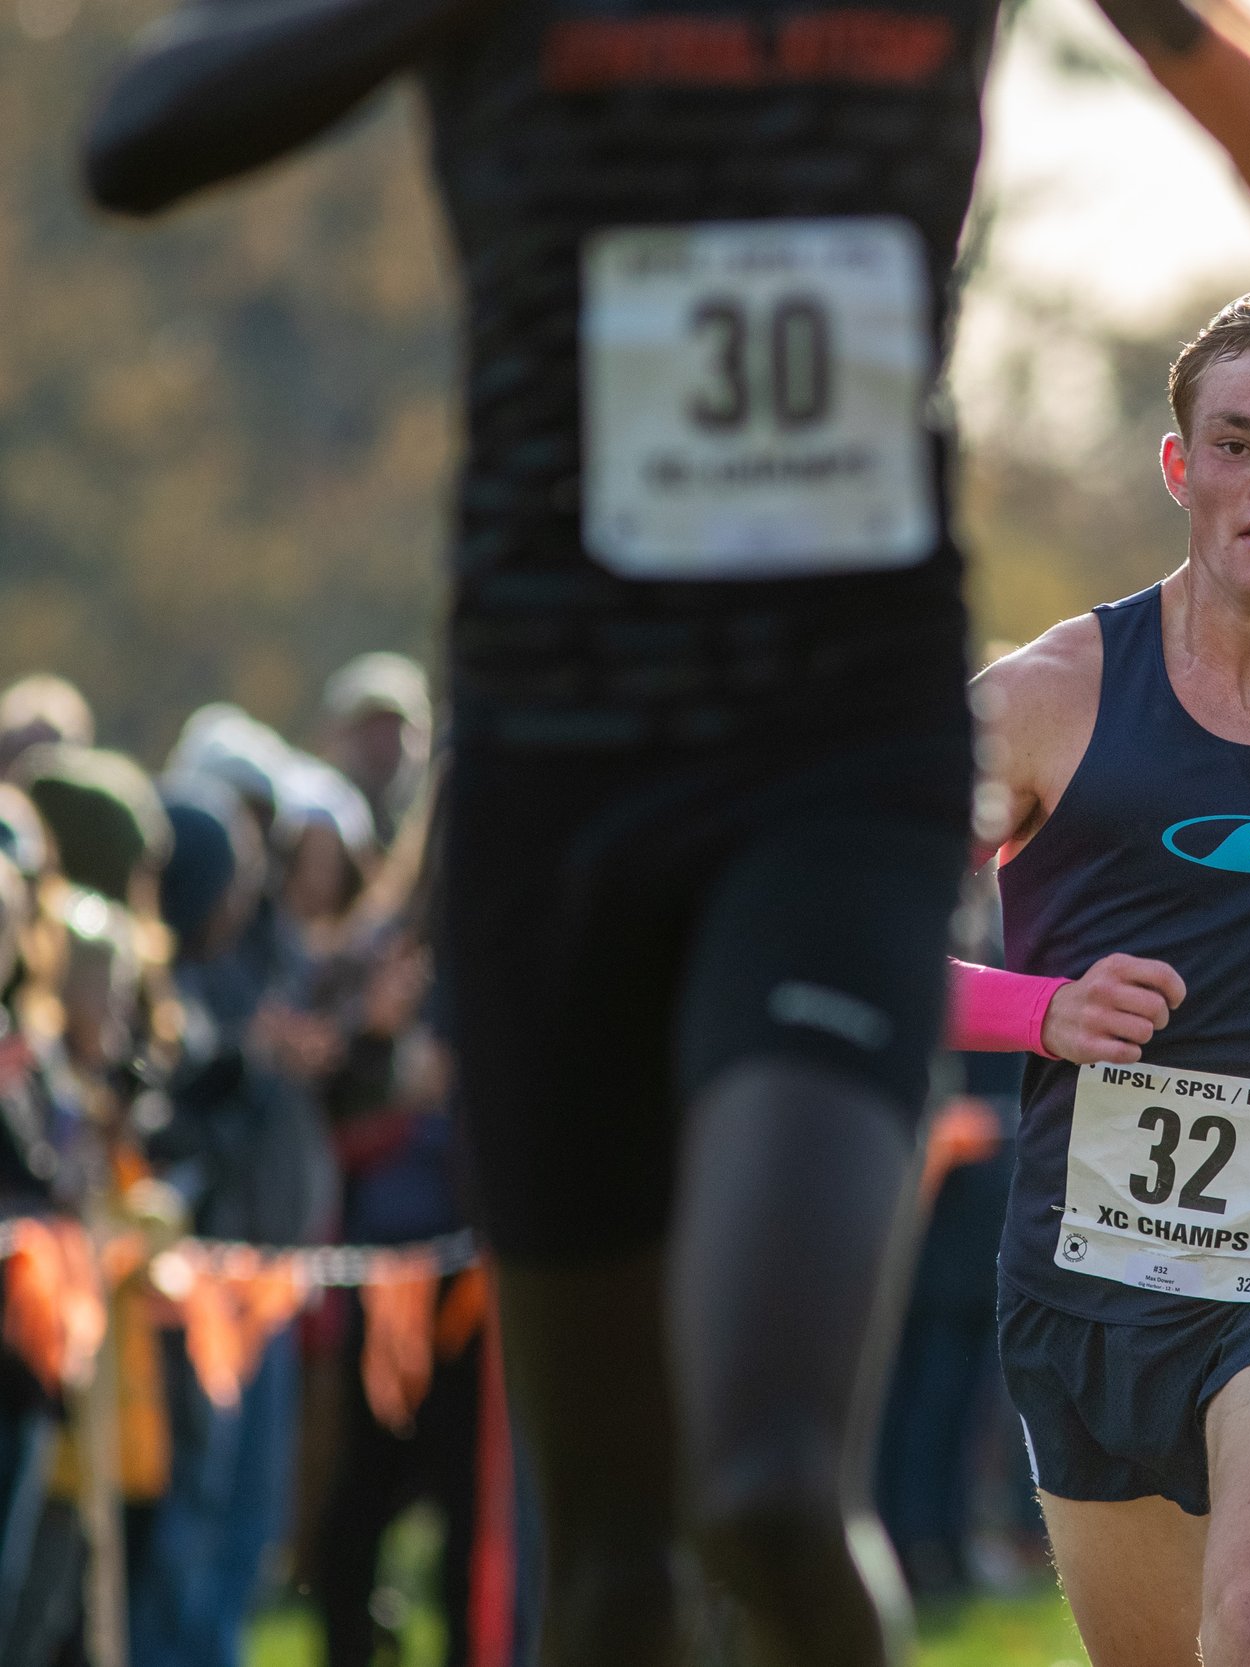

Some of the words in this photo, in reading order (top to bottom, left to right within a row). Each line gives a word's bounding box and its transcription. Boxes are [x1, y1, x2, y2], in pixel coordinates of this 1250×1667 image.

[685, 288, 834, 434] 30
[1102, 1067, 1155, 1090] NPSL
[1175, 1080, 1226, 1101] SPSL
[1129, 1106, 1236, 1215] 32
[1097, 1205, 1129, 1230] XC
[1137, 1216, 1250, 1252] CHAMPS
[1153, 1265, 1168, 1275] #32
